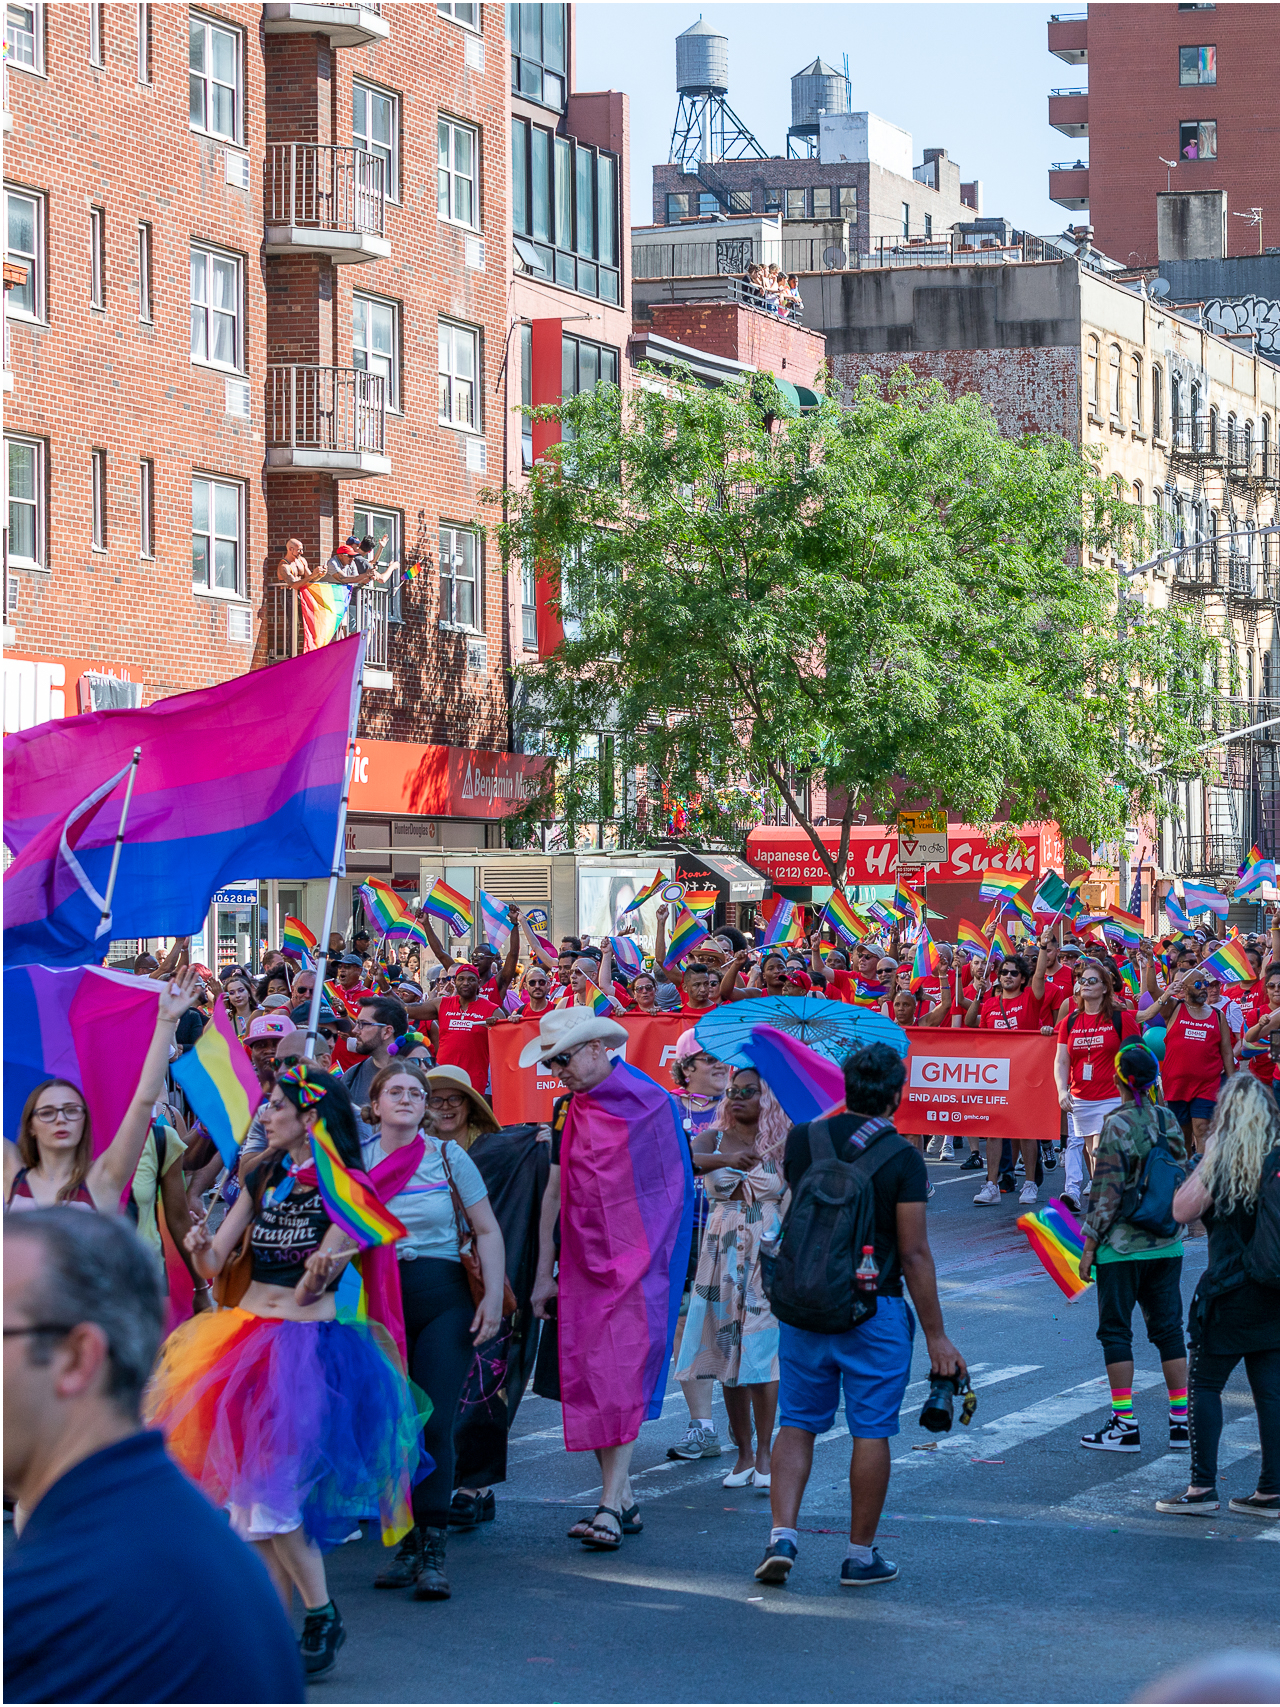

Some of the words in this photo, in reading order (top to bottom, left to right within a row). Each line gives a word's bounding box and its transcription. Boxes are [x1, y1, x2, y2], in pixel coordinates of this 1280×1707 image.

[474, 767, 513, 805] Benjamin
[394, 823, 429, 838] HunterDouglas
[754, 849, 810, 864] Japanese
[950, 842, 1036, 876] Sushi
[775, 866, 801, 879] (212)
[1187, 1029, 1205, 1037] GMHC
[1076, 1035, 1102, 1045] GMHC
[921, 1061, 999, 1085] GMHC
[536, 1081, 556, 1091] END
[909, 1093, 931, 1103] END
[932, 1093, 959, 1104] AIDS.
[961, 1094, 984, 1104] LIVE
[985, 1095, 1009, 1105] LIFE.
[963, 1113, 990, 1122] gmhc.org
[278, 1214, 310, 1227] thing
[252, 1223, 318, 1249] traight
